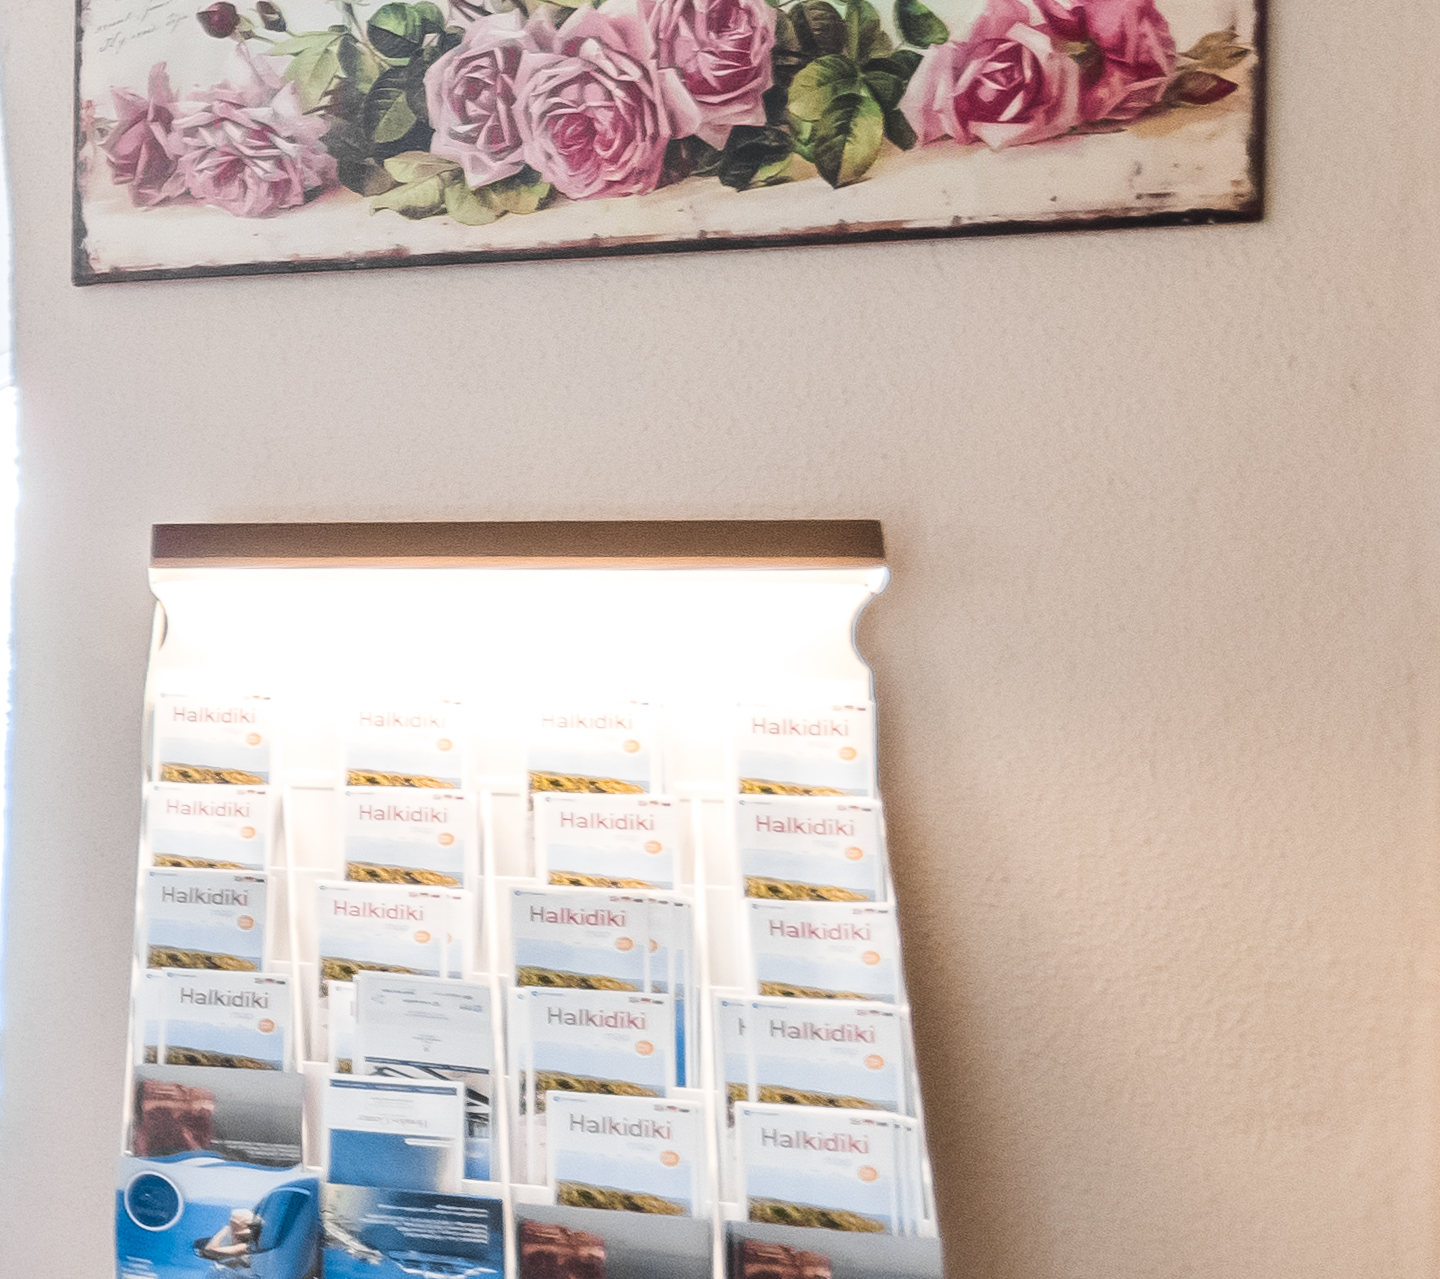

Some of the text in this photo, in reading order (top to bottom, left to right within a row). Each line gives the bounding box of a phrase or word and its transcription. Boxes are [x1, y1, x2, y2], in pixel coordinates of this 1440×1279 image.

[173, 706, 256, 724] Halkidiki
[751, 717, 849, 737] Halkidiki
[166, 800, 250, 818] Halkidiki
[359, 804, 448, 823] Halkidiki
[560, 811, 655, 831] Halkidiki
[756, 815, 854, 836] Halkidiki
[162, 886, 248, 907] Halkidiki
[333, 901, 424, 921] Halkidiki
[530, 906, 627, 928] Halkidiki
[769, 919, 870, 941] Halkidiki
[180, 988, 269, 1009] Halkidiki
[547, 1007, 646, 1030] Halkidiki
[770, 1020, 876, 1044] Halkidiki
[569, 1114, 671, 1140] Halkidiki
[761, 1127, 869, 1155] Halkidiki
